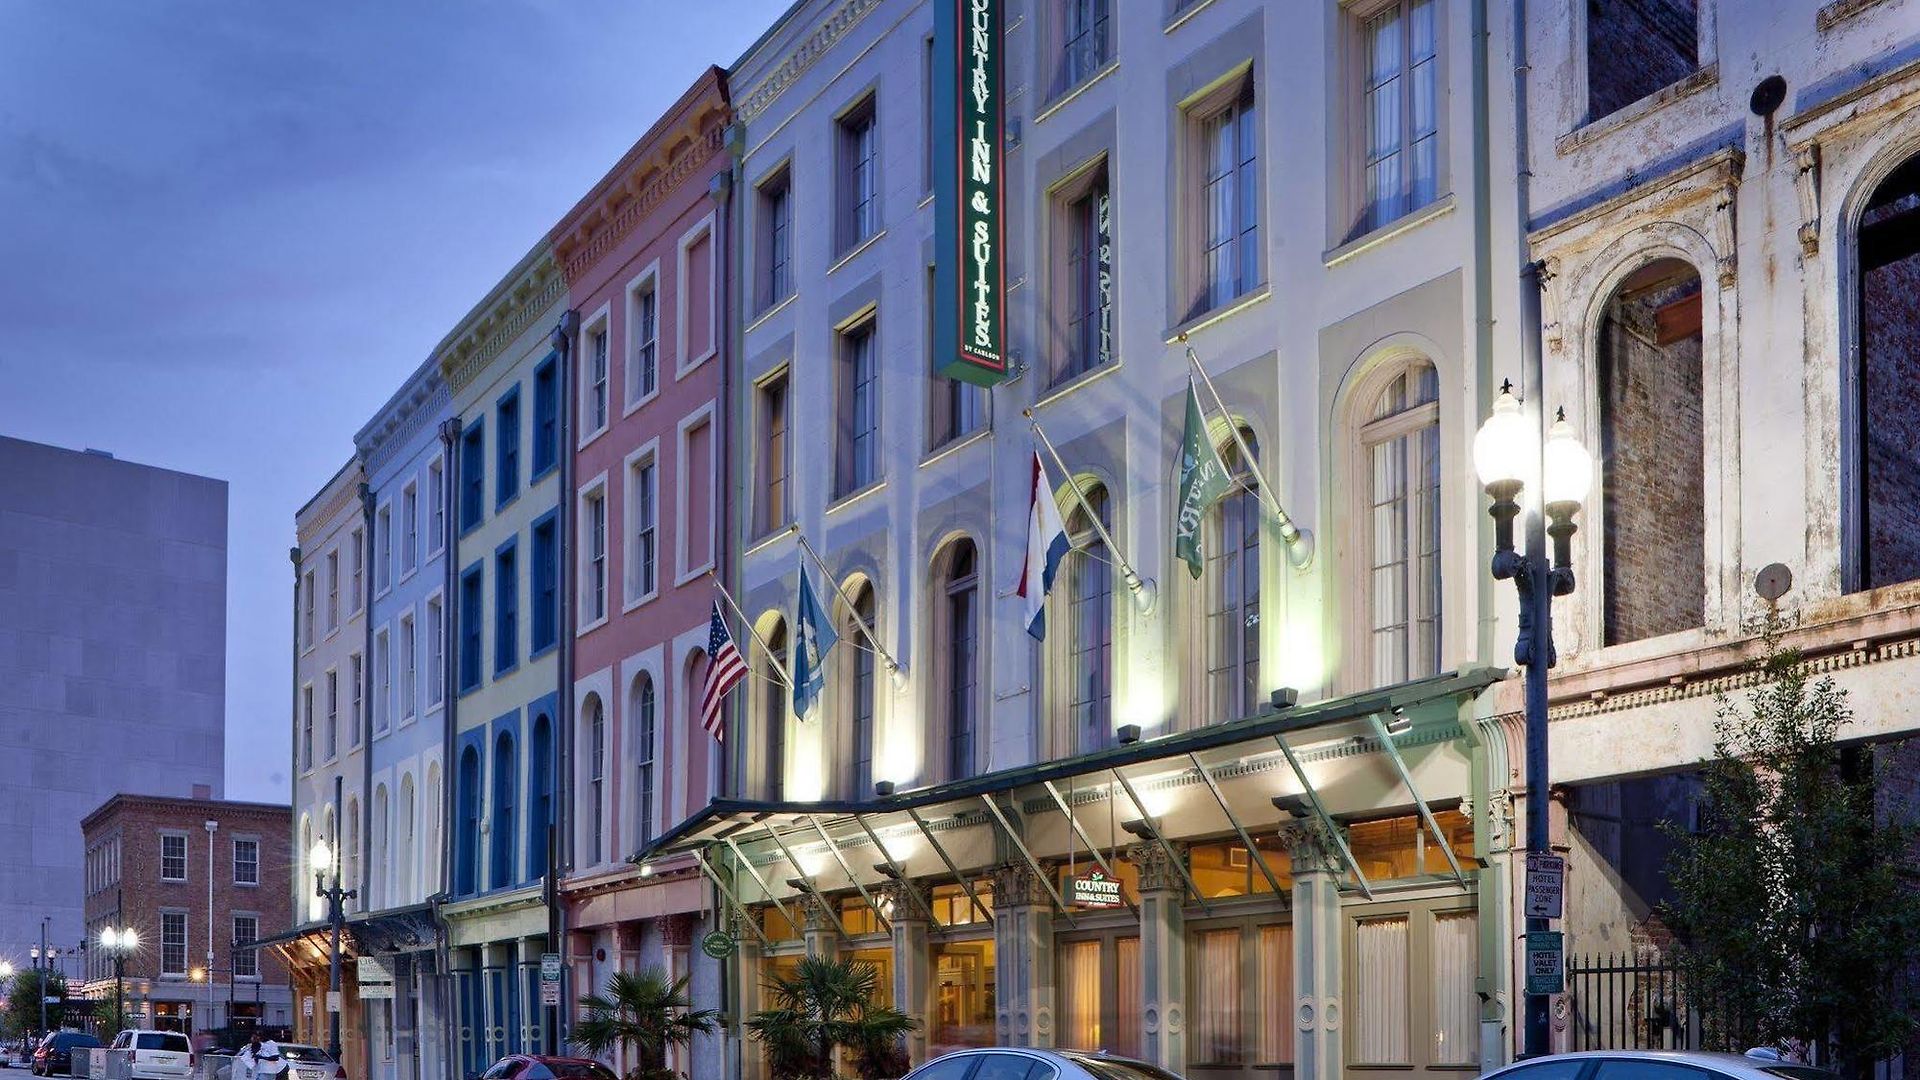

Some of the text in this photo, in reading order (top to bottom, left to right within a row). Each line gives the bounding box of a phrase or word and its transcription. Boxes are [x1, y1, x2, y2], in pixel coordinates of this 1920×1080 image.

[971, 120, 990, 184] INN
[971, 190, 990, 214] &
[973, 348, 1000, 360] CARLSON
[1532, 875, 1556, 884] HOTEL
[1075, 880, 1120, 893] COUNTRY
[1528, 885, 1560, 895] PASSENGER
[1534, 895, 1552, 903] ZONE
[1532, 951, 1557, 959] HOTEL
[1535, 967, 1555, 975] ONLY
